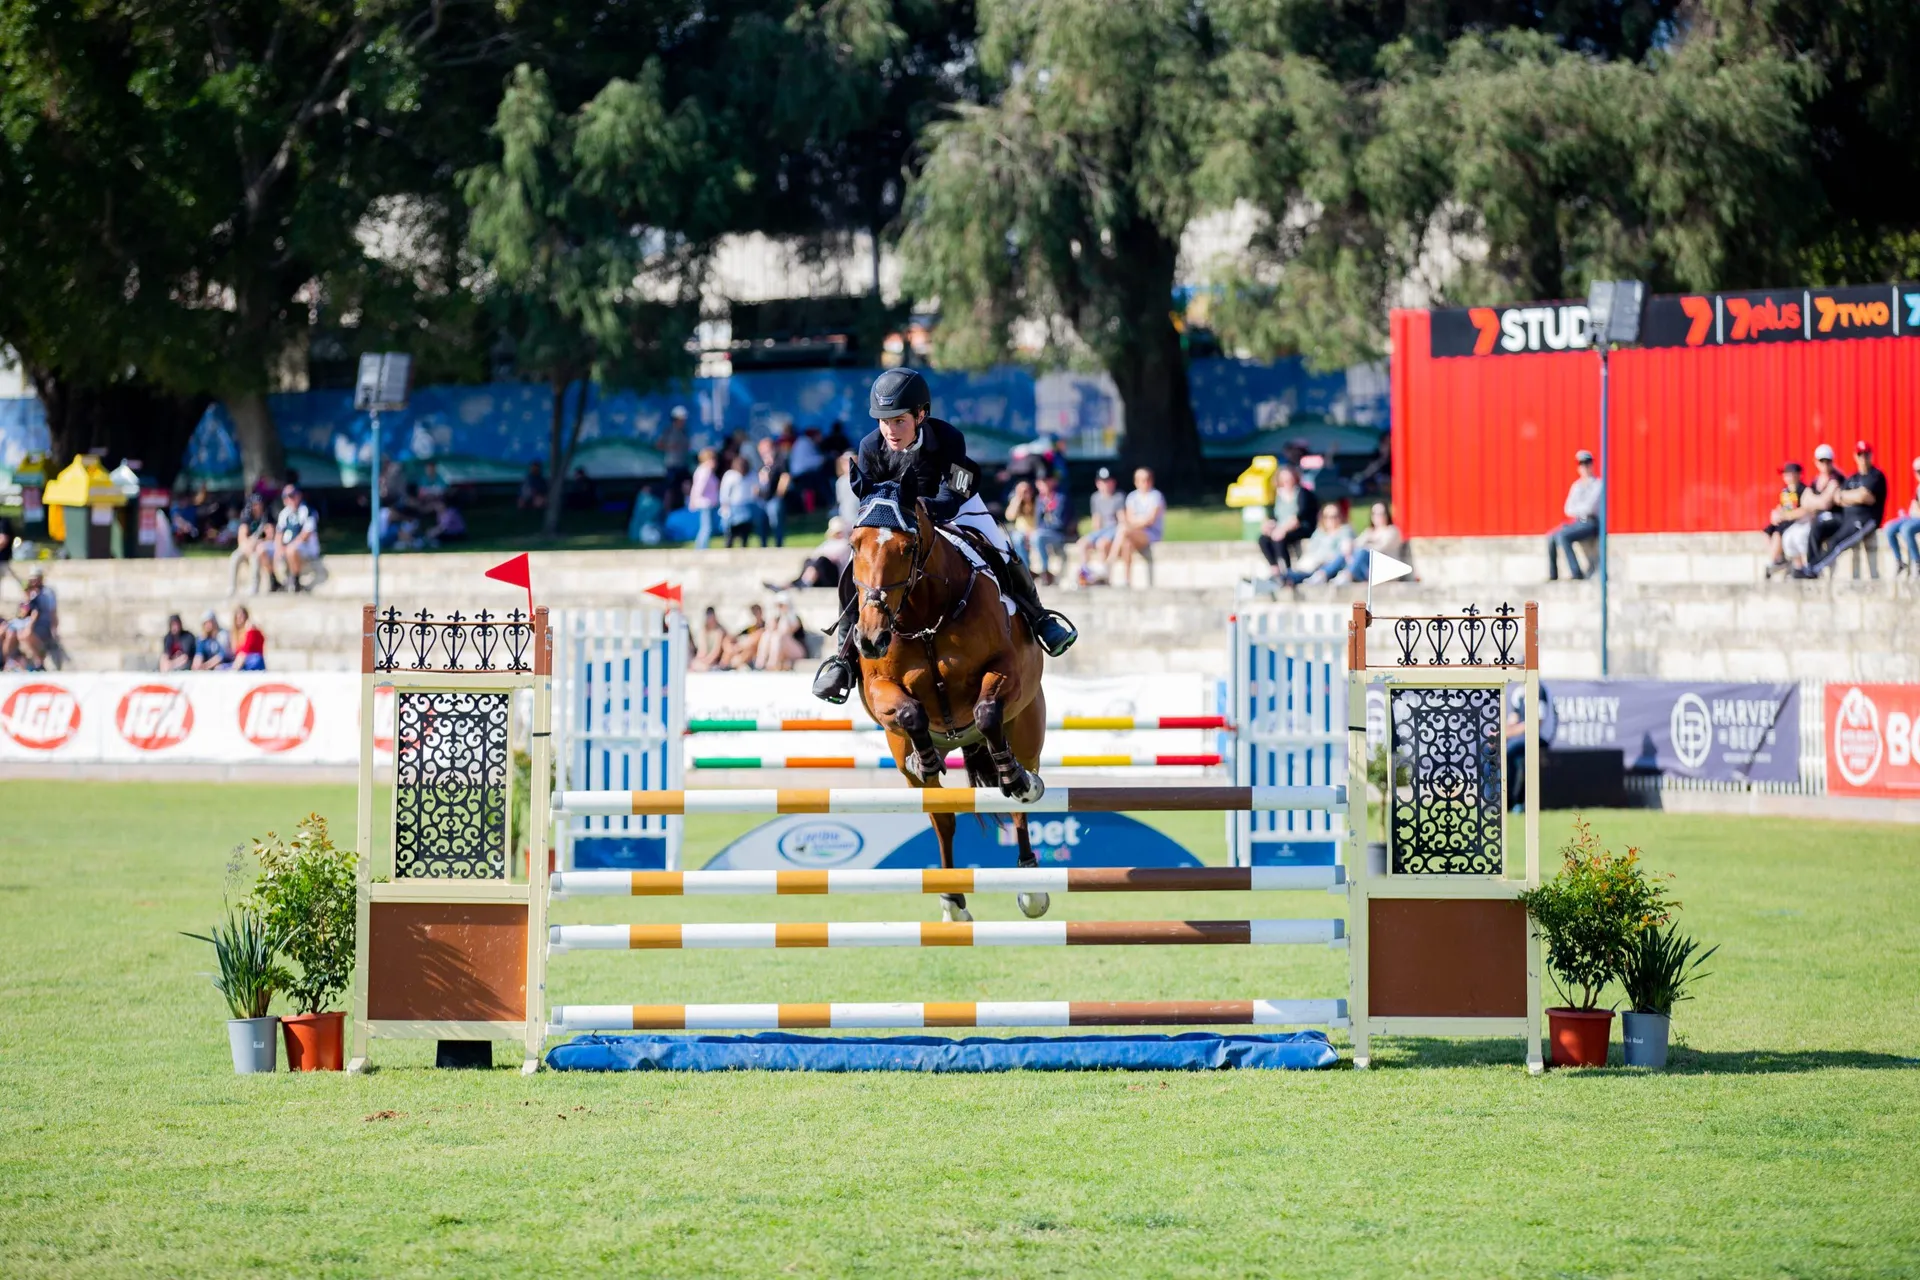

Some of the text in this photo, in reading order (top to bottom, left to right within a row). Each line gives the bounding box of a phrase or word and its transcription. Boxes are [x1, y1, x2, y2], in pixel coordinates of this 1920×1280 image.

[1680, 296, 1713, 346] 7
[956, 470, 969, 493] 04
[123, 692, 187, 738] IGA
[1712, 699, 1780, 727] HARVEY
